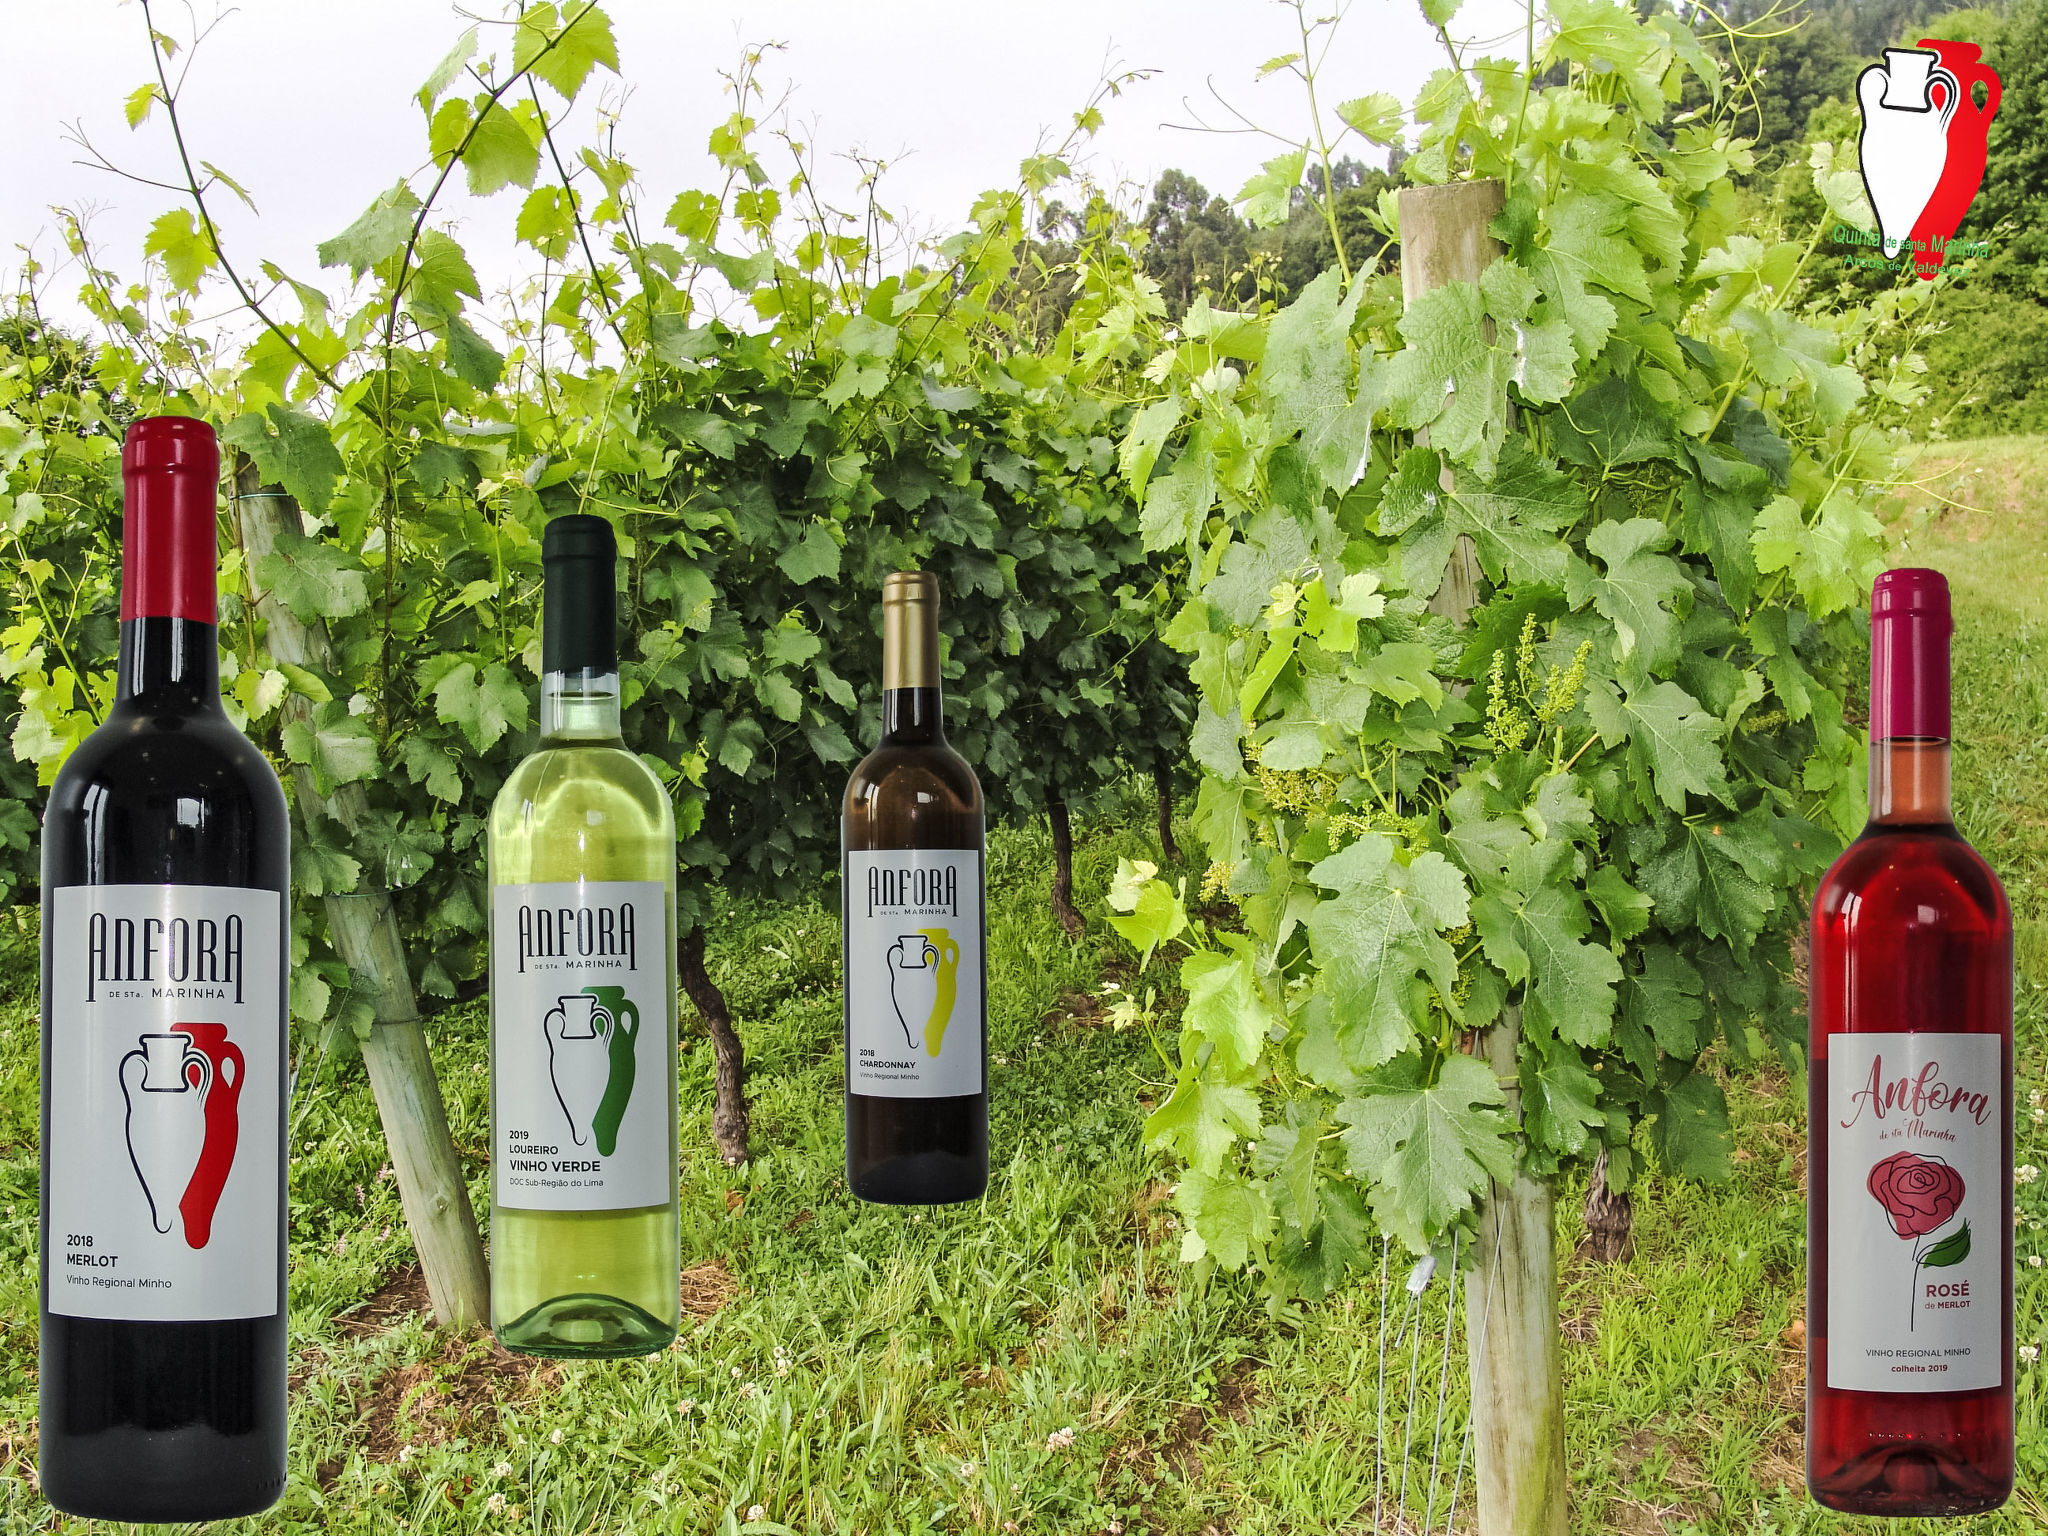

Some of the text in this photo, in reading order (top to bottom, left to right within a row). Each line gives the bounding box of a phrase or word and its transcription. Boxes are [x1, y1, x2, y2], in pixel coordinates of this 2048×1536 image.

[867, 866, 958, 917] ANFORA
[518, 903, 638, 973] ANFORA
[86, 912, 245, 1004] ANFORA
[566, 960, 622, 968] MARINHA
[152, 988, 225, 999] MARINHA
[860, 1049, 875, 1057] 2018
[859, 1060, 916, 1069] CHARDONNAY
[874, 1073, 899, 1081] Regional
[1840, 1054, 1992, 1129] Anfora
[509, 1131, 529, 1140] 2019
[1879, 1119, 1957, 1143] de sta Marinha
[509, 1145, 559, 1155] LOUREIRO
[510, 1160, 601, 1172] VINHO VERDE
[509, 1178, 524, 1186] DOC
[525, 1178, 568, 1188] Sub-Região
[584, 1178, 604, 1187] Lima
[67, 1234, 93, 1247] 2018
[67, 1253, 118, 1268] MERLOT
[66, 1274, 172, 1289] Vinho Regional Minho
[1926, 1280, 1970, 1298] ROSÉ
[1925, 1300, 1971, 1309] de MERLOT
[1866, 1347, 1971, 1357] VINHO REGIONAL MINHO
[1891, 1363, 1948, 1373] colheita 2019
